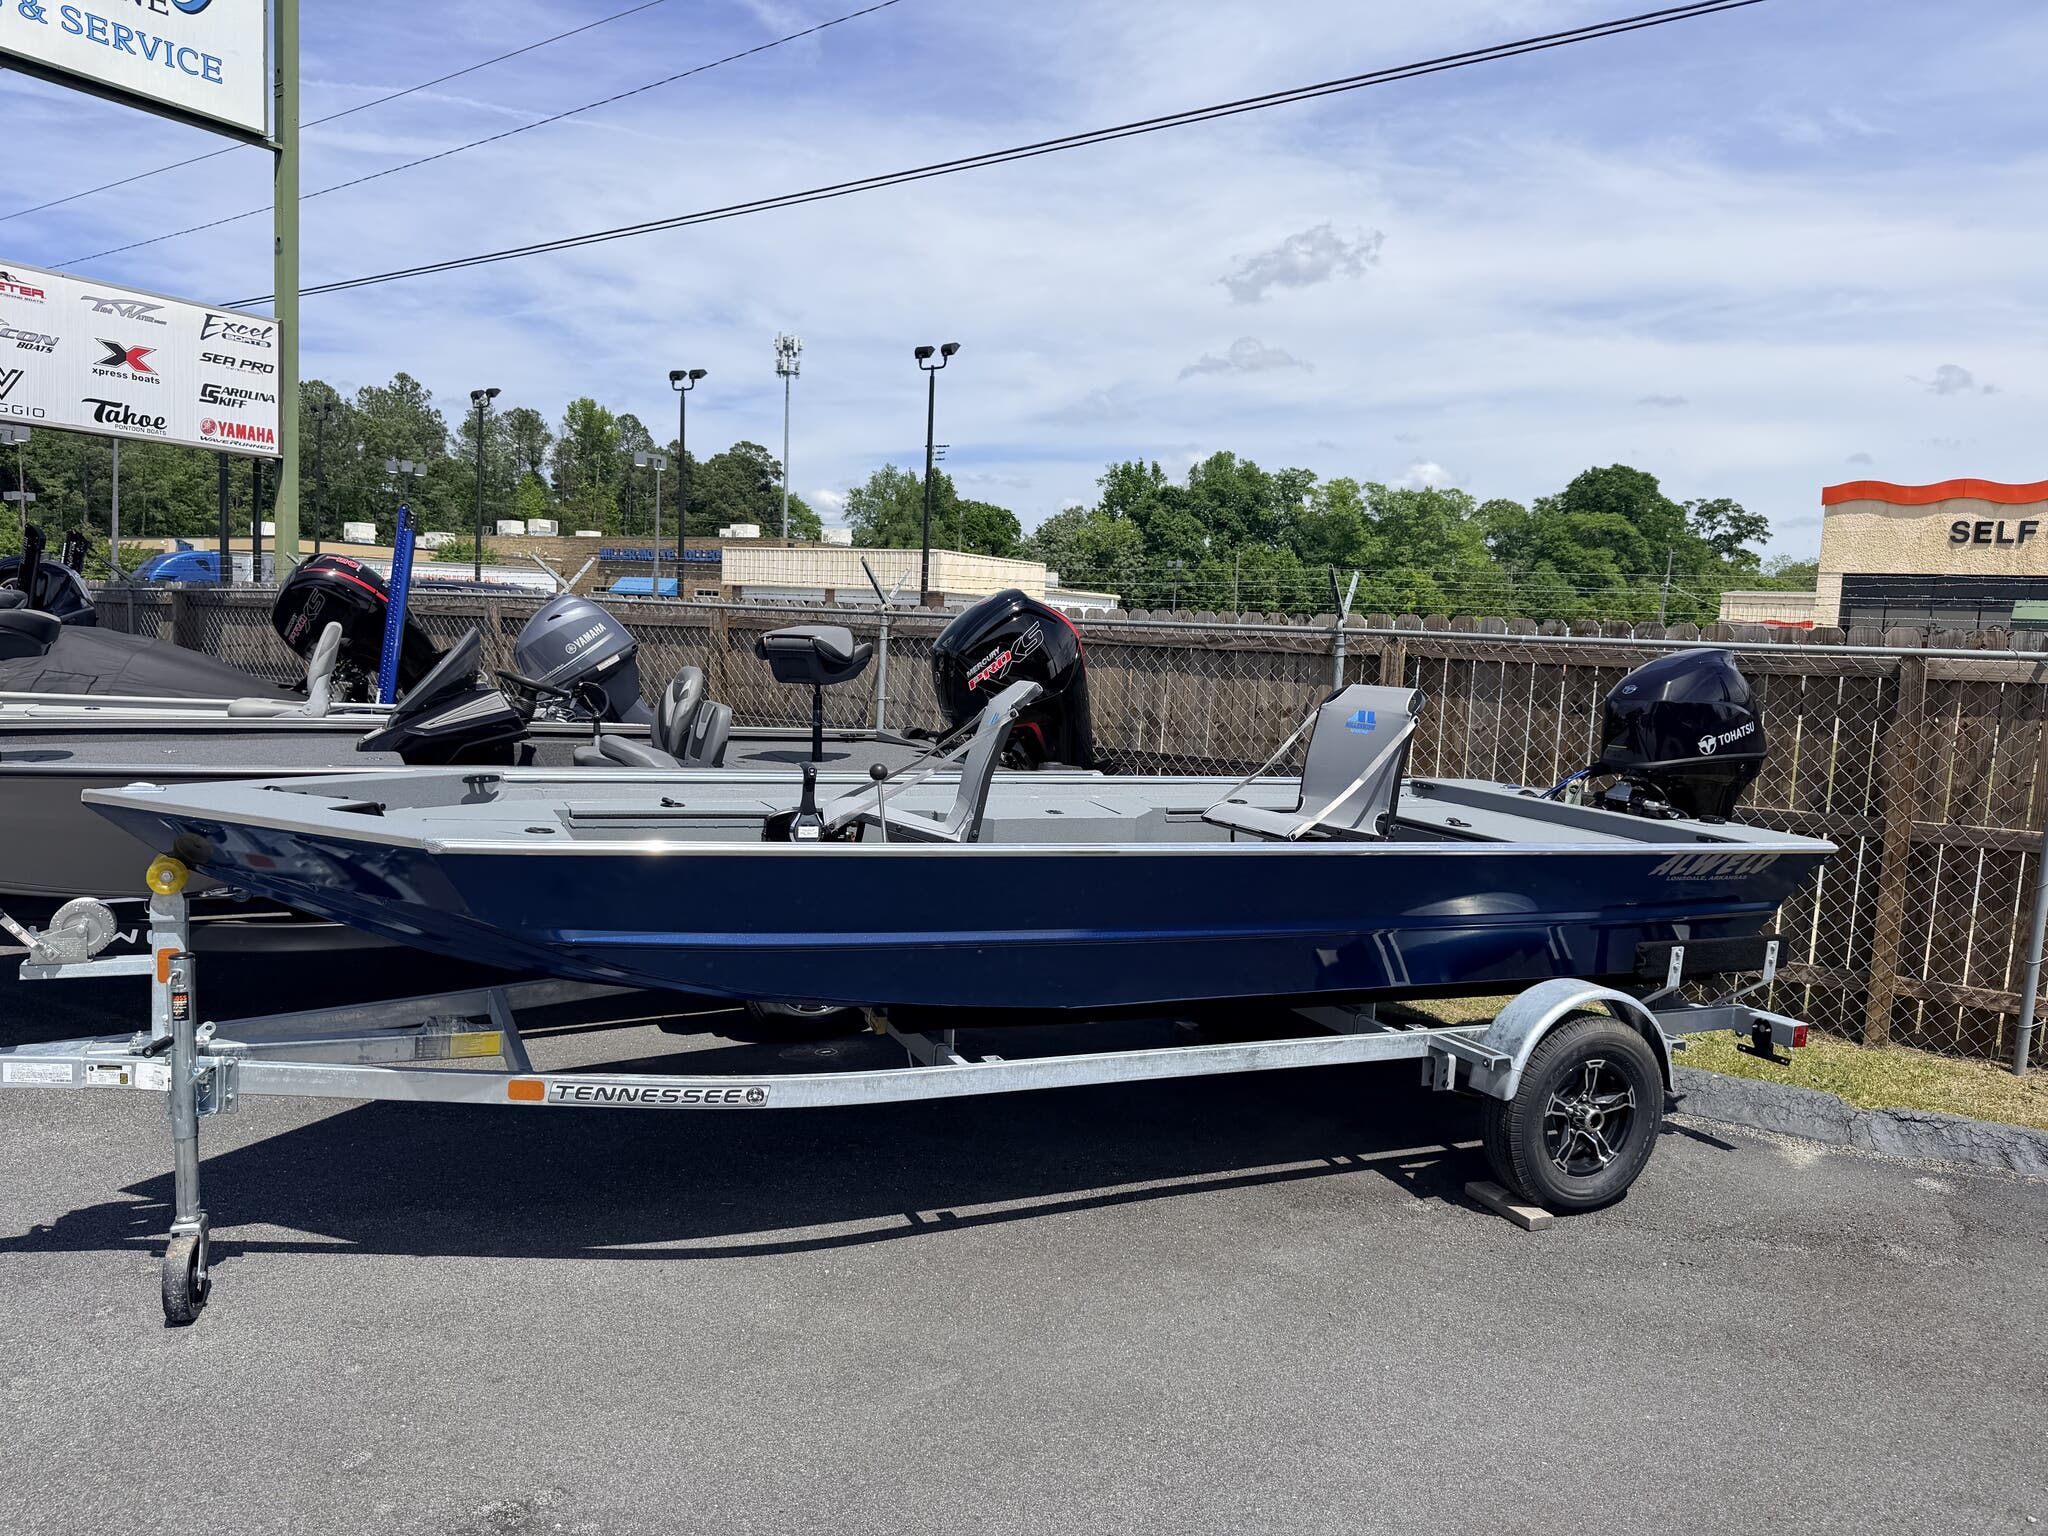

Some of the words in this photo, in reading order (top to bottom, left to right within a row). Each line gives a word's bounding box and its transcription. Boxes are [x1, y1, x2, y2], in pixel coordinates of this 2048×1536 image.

[18, 0, 48, 25] &
[60, 5, 223, 85] SERVICE
[200, 313, 274, 341] Excel
[16, 341, 54, 354] BOATS
[91, 367, 128, 380] xpress
[131, 372, 161, 385] boats
[199, 352, 236, 367] SEA
[239, 359, 275, 376] PRO
[199, 389, 248, 409] SKIFF
[200, 383, 276, 404] CAROLINA
[81, 398, 168, 430] Tahoe
[114, 423, 145, 433] PONTOON
[146, 427, 167, 436] BOATS
[217, 420, 275, 445] YAMAHA
[1949, 520, 2040, 544] SELF
[573, 622, 607, 649] YAMAHA
[966, 645, 1001, 679] MERCURY
[968, 650, 1012, 691] PRO
[999, 621, 1044, 679] XS
[1717, 721, 1755, 746] TOHATSU
[1647, 853, 1781, 877] ALWELD
[556, 1084, 743, 1104] TENNESSEE
